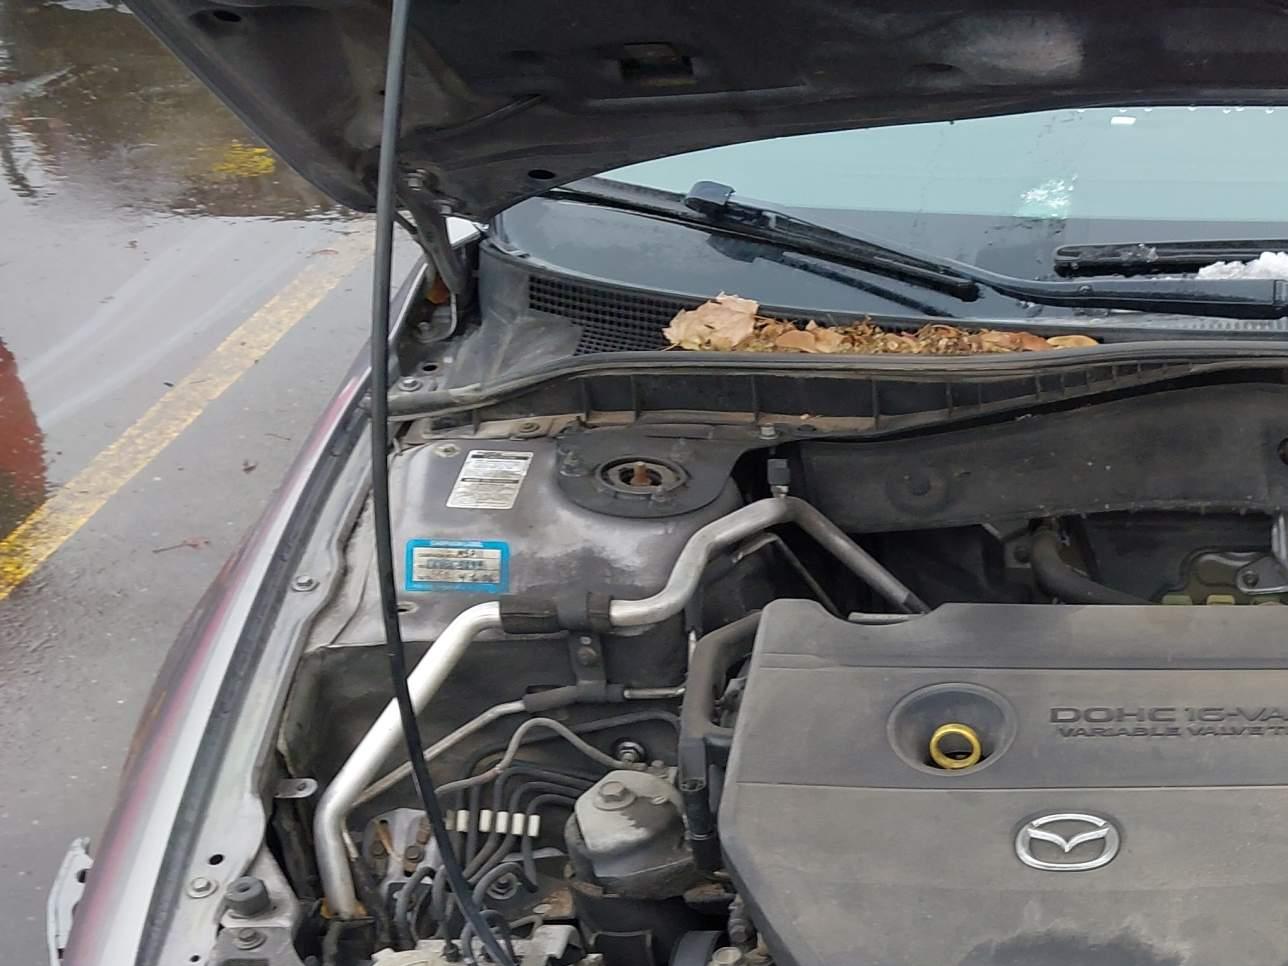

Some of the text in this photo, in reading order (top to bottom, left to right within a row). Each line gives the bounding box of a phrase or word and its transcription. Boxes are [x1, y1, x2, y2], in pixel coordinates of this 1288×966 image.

[1049, 707, 1177, 723] DOHC
[1058, 726, 1181, 737] VARIABLE
[1187, 725, 1265, 736] VALVE
